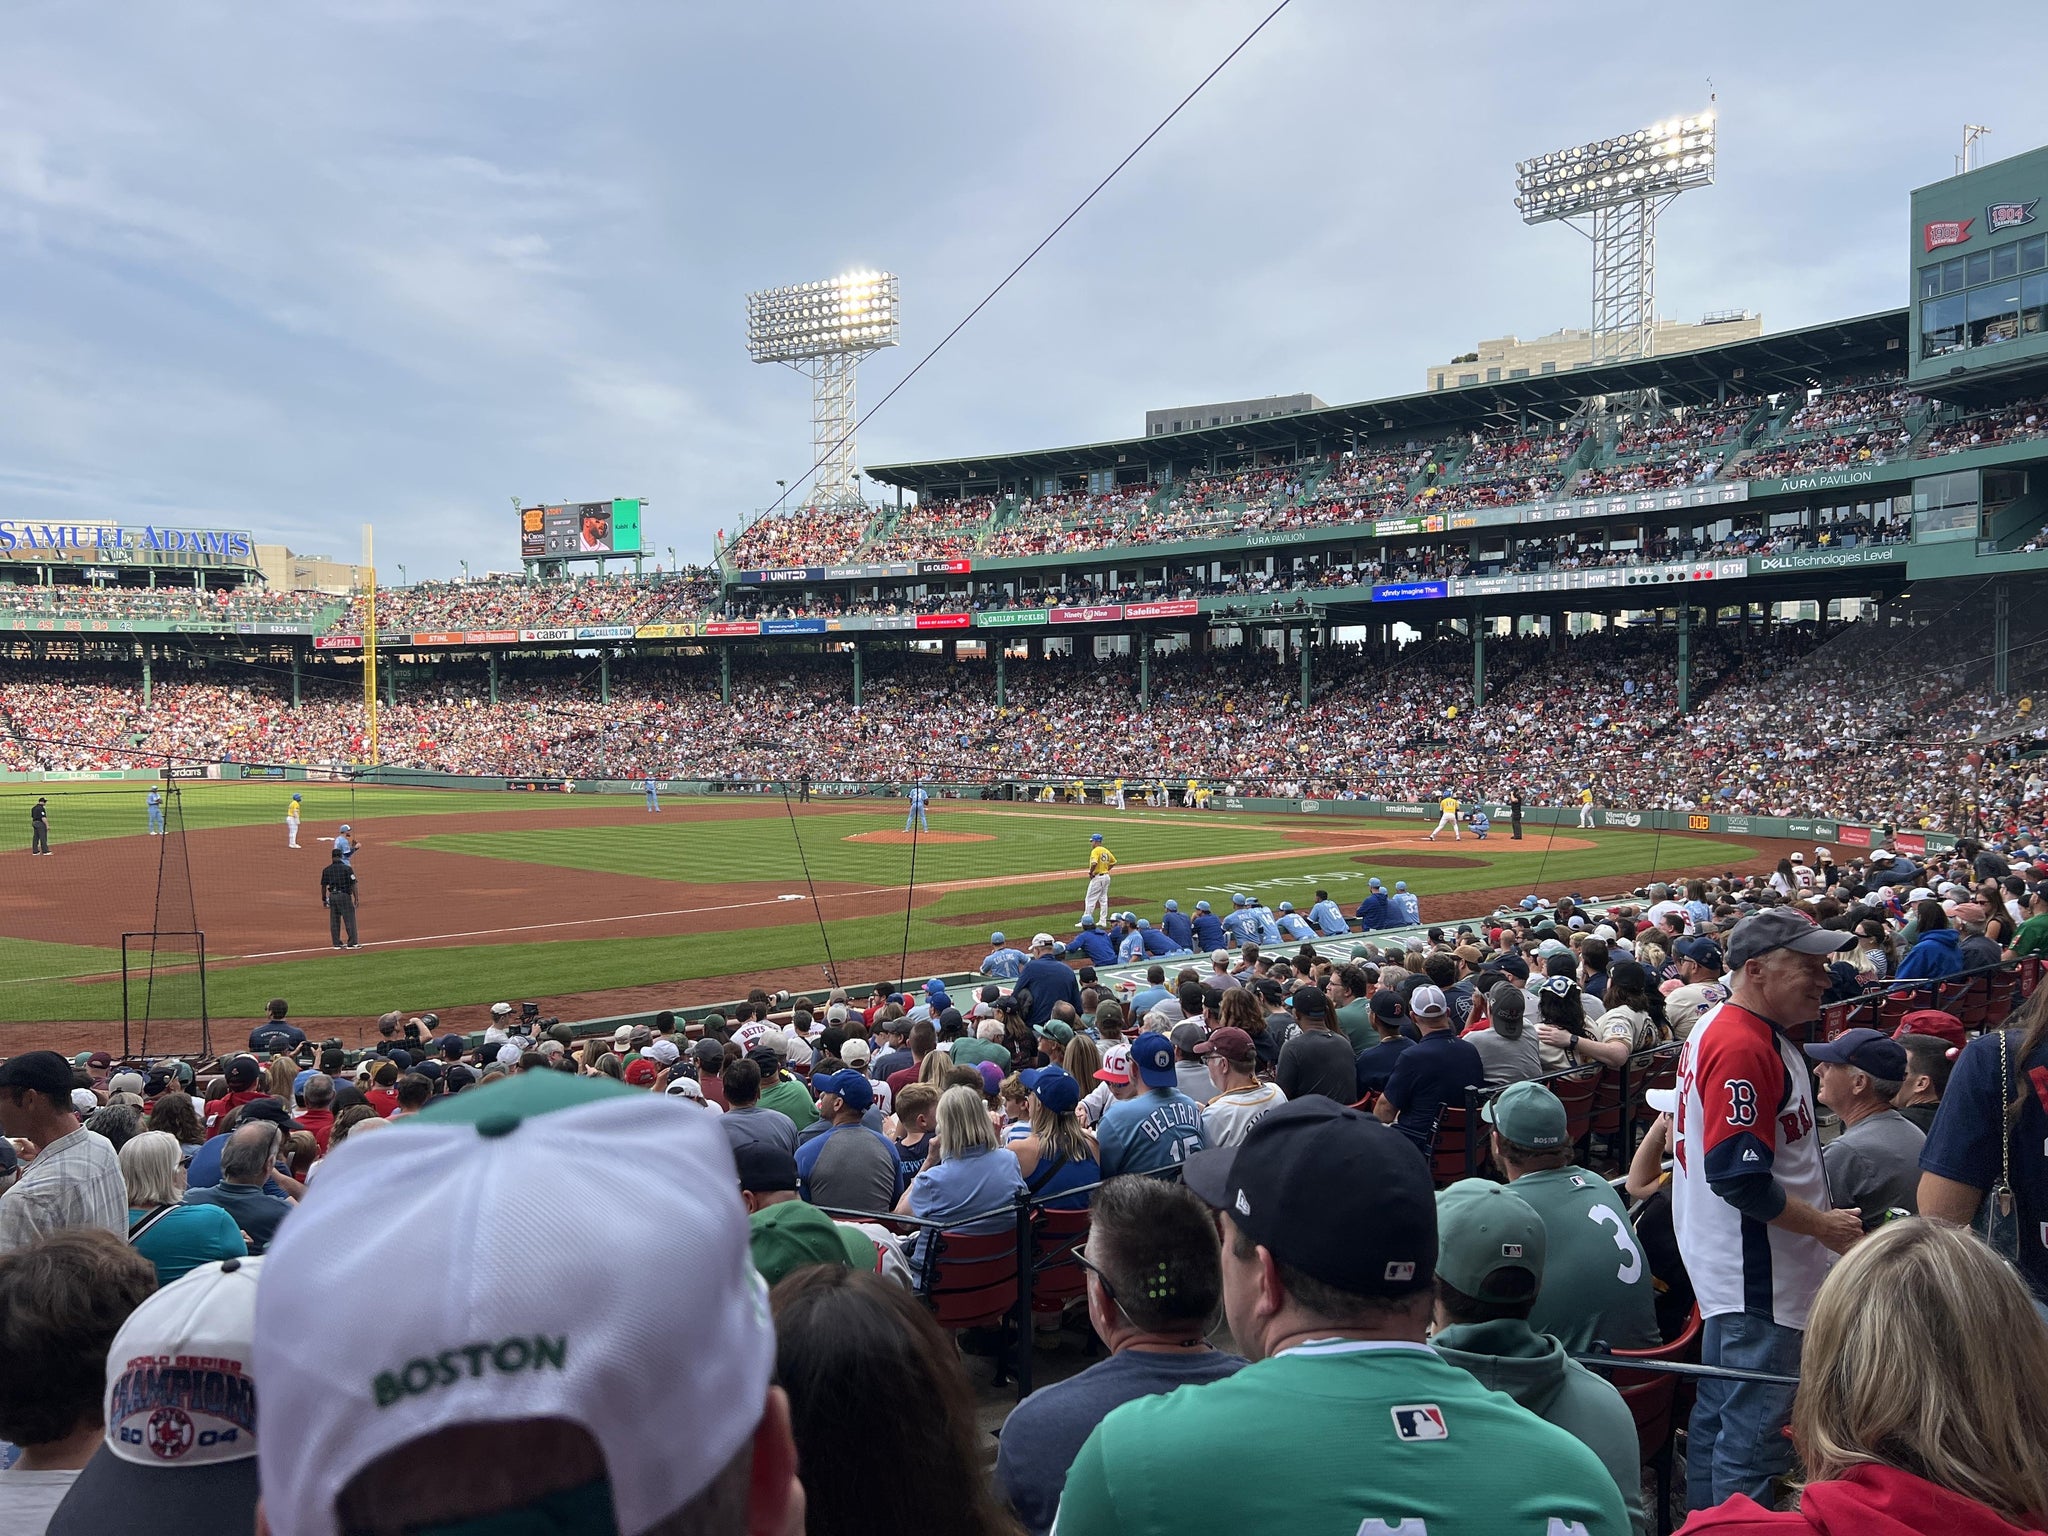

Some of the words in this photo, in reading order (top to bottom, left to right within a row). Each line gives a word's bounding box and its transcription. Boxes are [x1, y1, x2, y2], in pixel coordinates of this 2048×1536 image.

[1992, 208, 2023, 223] 1904
[1930, 227, 1960, 241] 1903
[1820, 471, 1872, 487] PAVILION
[1532, 511, 1542, 520] 52
[1555, 509, 1570, 518] 223
[1582, 506, 1598, 515] .231
[1609, 504, 1626, 513] .260
[1637, 501, 1654, 510] .335
[1665, 498, 1682, 507] .595
[1698, 495, 1704, 503] 3
[1724, 491, 1735, 500] 23
[1453, 518, 1476, 528] STORY
[0, 521, 134, 552] SAMUEL
[139, 524, 251, 558] ADAMS
[1271, 533, 1305, 543] PAVILION
[1761, 556, 1792, 569] DELL
[1792, 550, 1860, 568] Technologies
[1863, 548, 1893, 561] Level
[932, 563, 950, 571] OLED
[1634, 567, 1654, 575] BALL
[1664, 565, 1688, 573] STRIKE
[1695, 562, 1710, 570] OUT
[1721, 563, 1743, 574] 6TH
[770, 571, 807, 581] UNITED
[1588, 575, 1606, 584] MVR
[1381, 589, 1401, 598] xfinity
[1401, 588, 1424, 597] Imagine
[1424, 586, 1438, 594] That
[1063, 611, 1083, 619] Ninety
[1093, 610, 1107, 618] Nine
[1126, 606, 1160, 617] Safelite
[988, 615, 1015, 623] GRILLO'S
[1017, 612, 1045, 621] PICKLES
[12, 620, 26, 630] 14
[92, 620, 109, 631] 34
[119, 621, 133, 631] 42
[270, 626, 298, 634] $22,514
[336, 638, 356, 646] PIZZA
[1385, 805, 1424, 814] smartwater
[1605, 811, 1626, 819] Ninety
[1605, 817, 1626, 825] Nine
[1186, 871, 1366, 894] WHOOP
[1802, 876, 1810, 886] 9
[741, 1025, 766, 1039] BETTS
[1104, 1055, 1126, 1072] KC
[1723, 1078, 1759, 1128] B
[1533, 1136, 1559, 1144] BOSTON
[1587, 1203, 1643, 1285] 3
[127, 1355, 170, 1368] WORLD
[175, 1355, 242, 1372] SERIES
[371, 1333, 568, 1408] BOSTON
[120, 1426, 143, 1446] 20
[198, 1427, 238, 1447] 04
